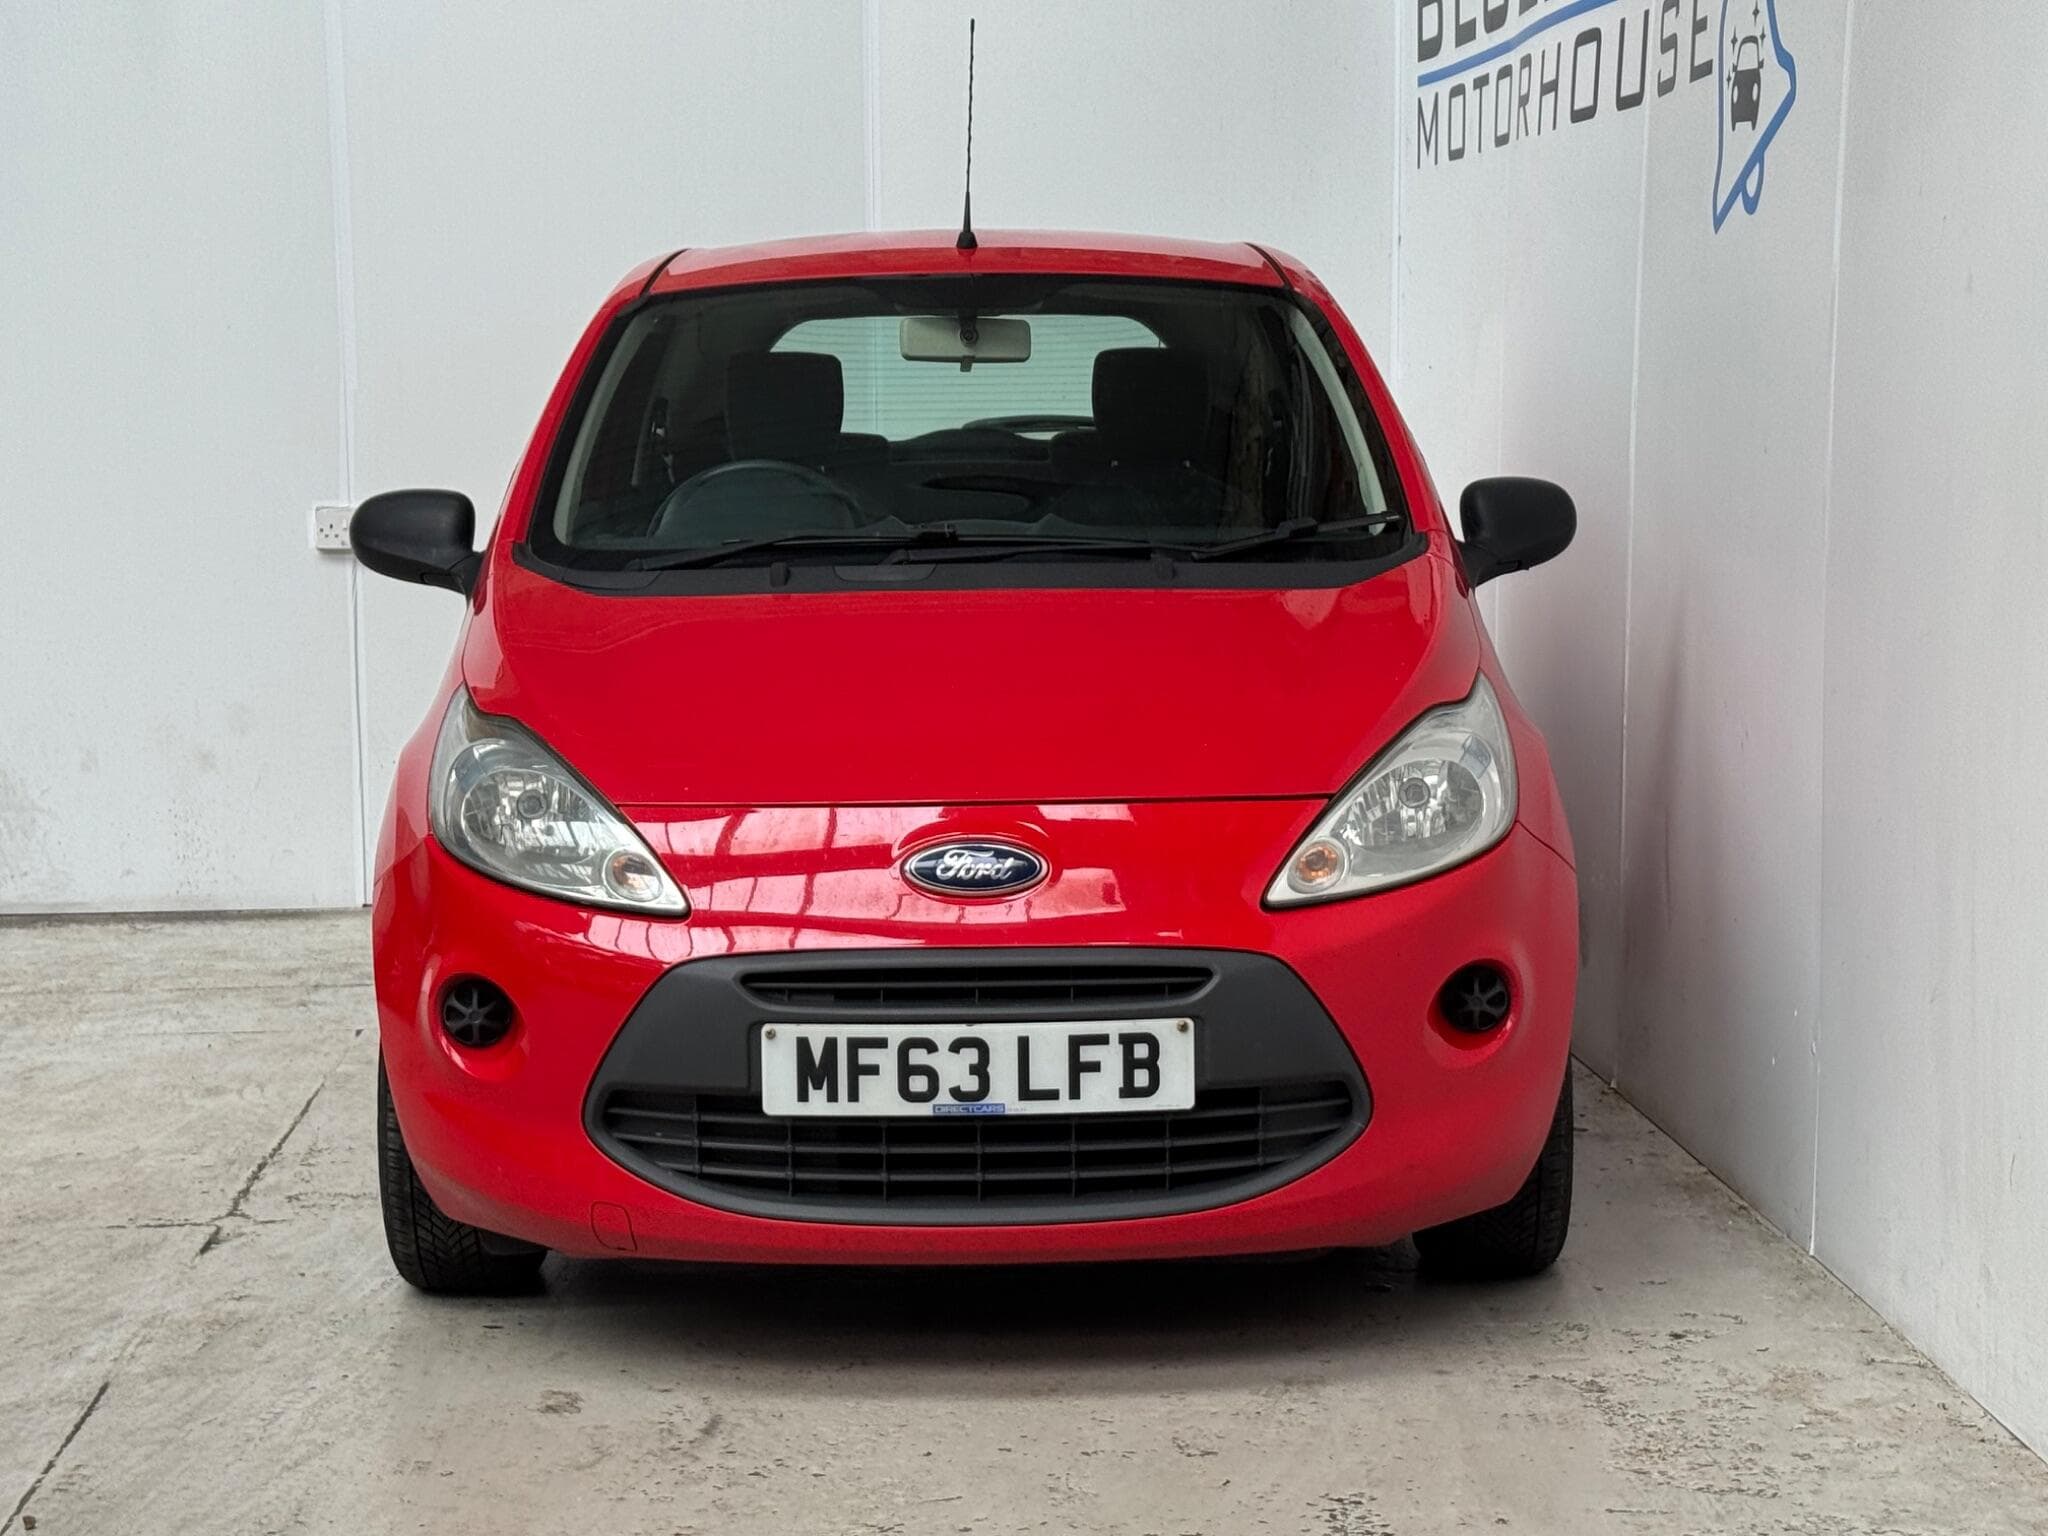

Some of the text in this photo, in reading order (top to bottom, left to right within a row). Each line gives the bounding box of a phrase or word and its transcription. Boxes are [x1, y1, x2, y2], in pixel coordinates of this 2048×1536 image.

[1417, 0, 1714, 169] MOTORHOUSE
[936, 849, 1014, 880] Ford
[796, 1032, 1160, 1103] MF63 LFB
